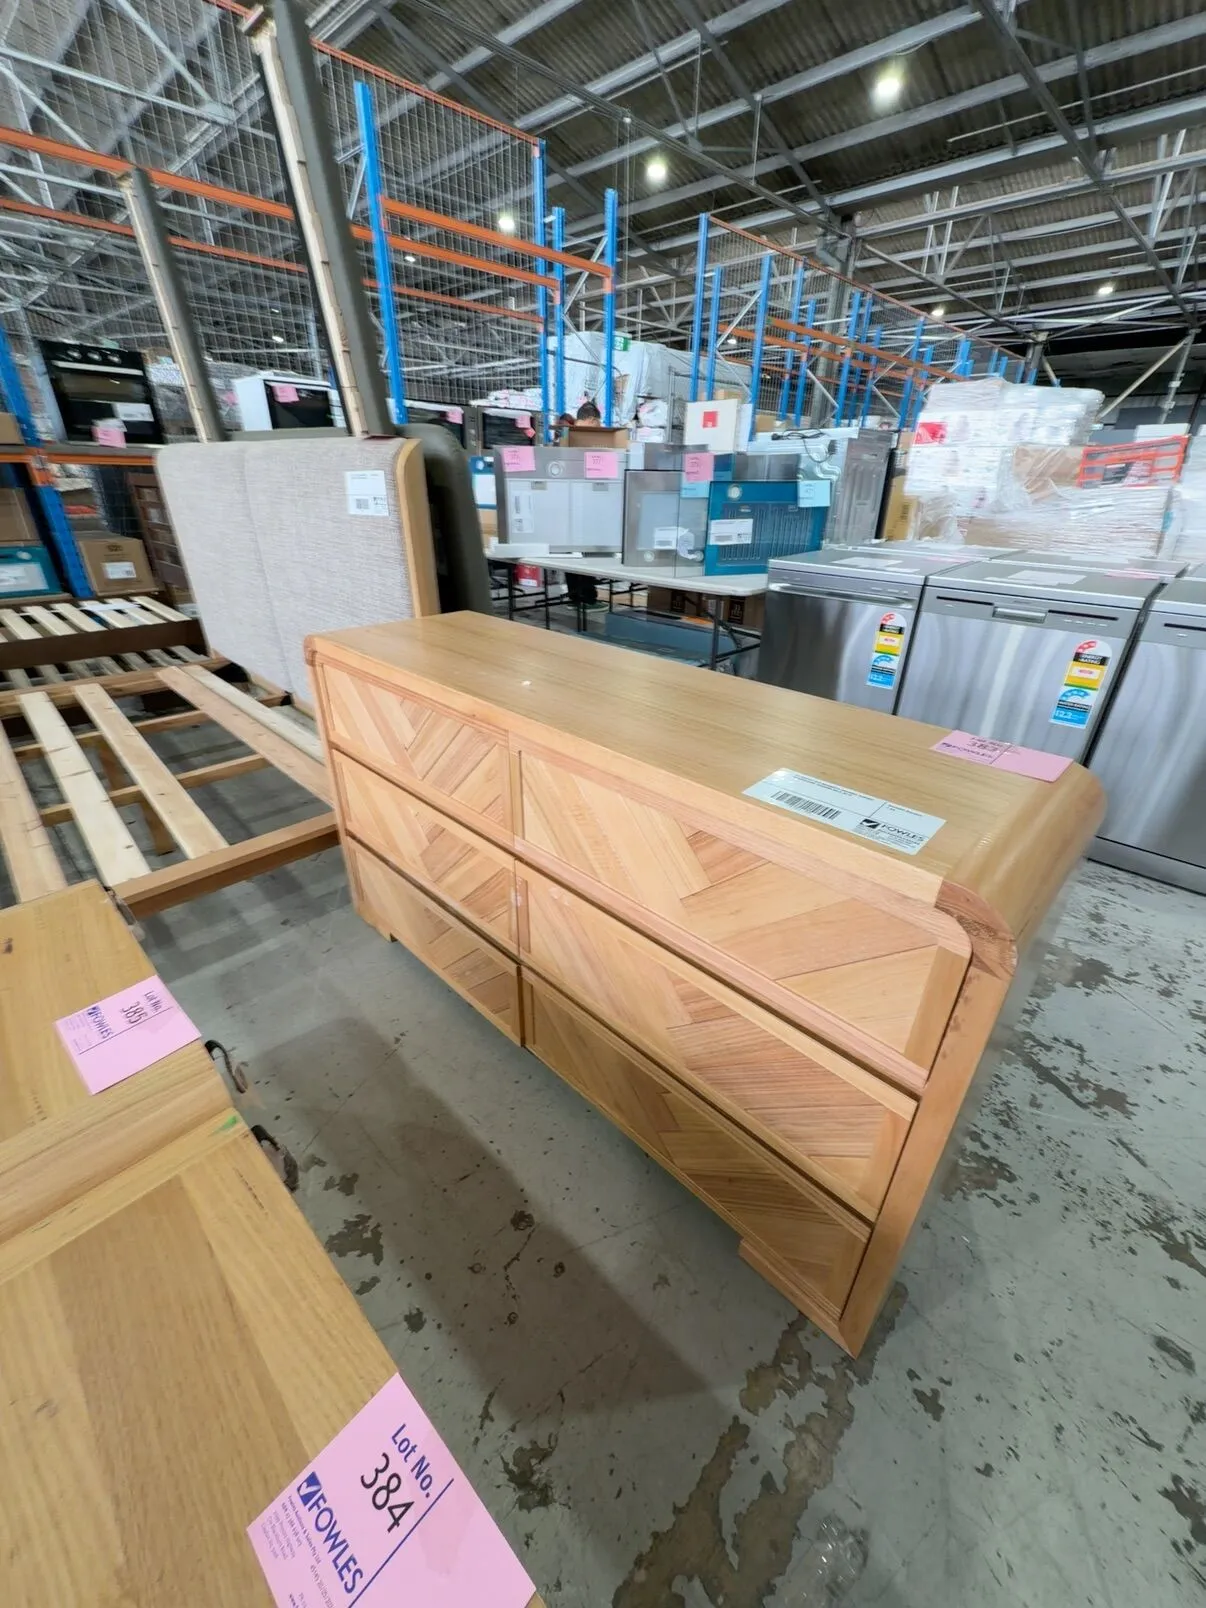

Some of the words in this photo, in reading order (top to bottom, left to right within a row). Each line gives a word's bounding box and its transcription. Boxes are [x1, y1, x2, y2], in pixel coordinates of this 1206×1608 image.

[879, 822, 925, 843] FOWLES
[91, 1011, 114, 1039] FOWLES
[121, 1001, 148, 1024] 385
[391, 1423, 417, 1463] Lot
[410, 1455, 434, 1498] No.
[360, 1452, 415, 1533] 384
[307, 1492, 364, 1594] FOWLES
